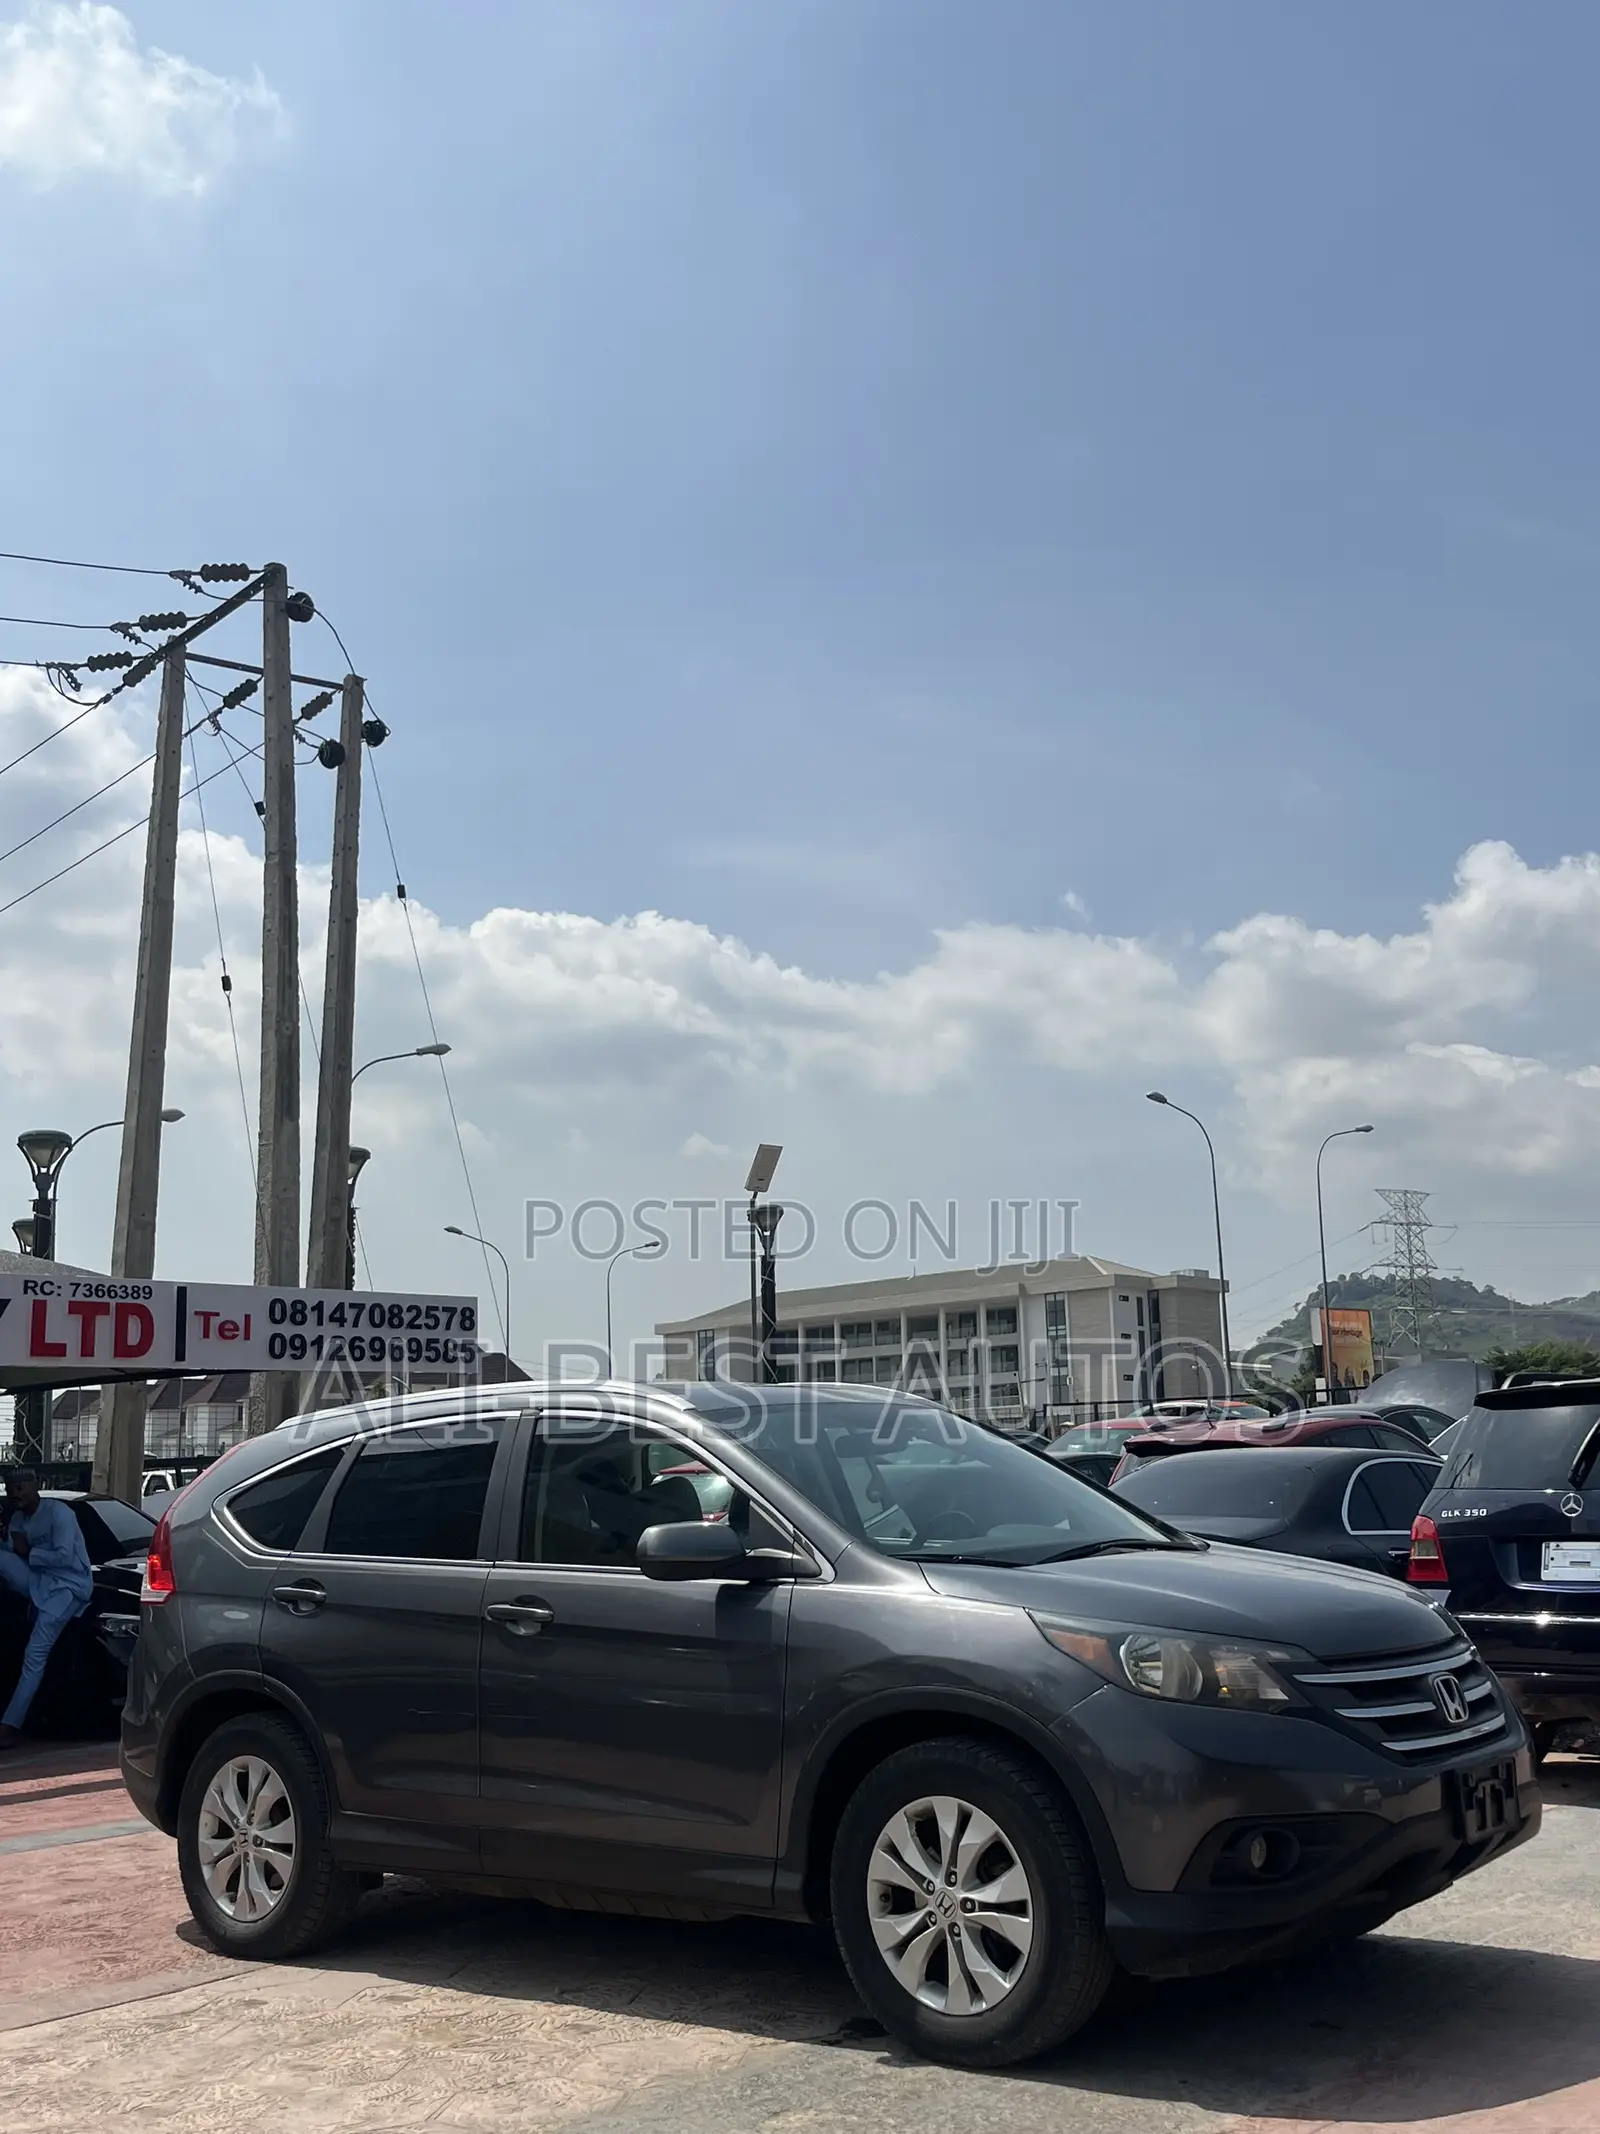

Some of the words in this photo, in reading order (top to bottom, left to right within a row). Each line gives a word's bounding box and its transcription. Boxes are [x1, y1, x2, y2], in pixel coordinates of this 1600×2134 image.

[23, 1279, 62, 1297] RC:
[69, 1282, 153, 1300] 7366389
[30, 1298, 154, 1358] LTD
[194, 1310, 251, 1341] Tel
[268, 1297, 476, 1332] 08147082578
[268, 1332, 476, 1364] 09126969585
[1441, 1510, 1461, 1518] GLK
[1464, 1508, 1487, 1517] 350
